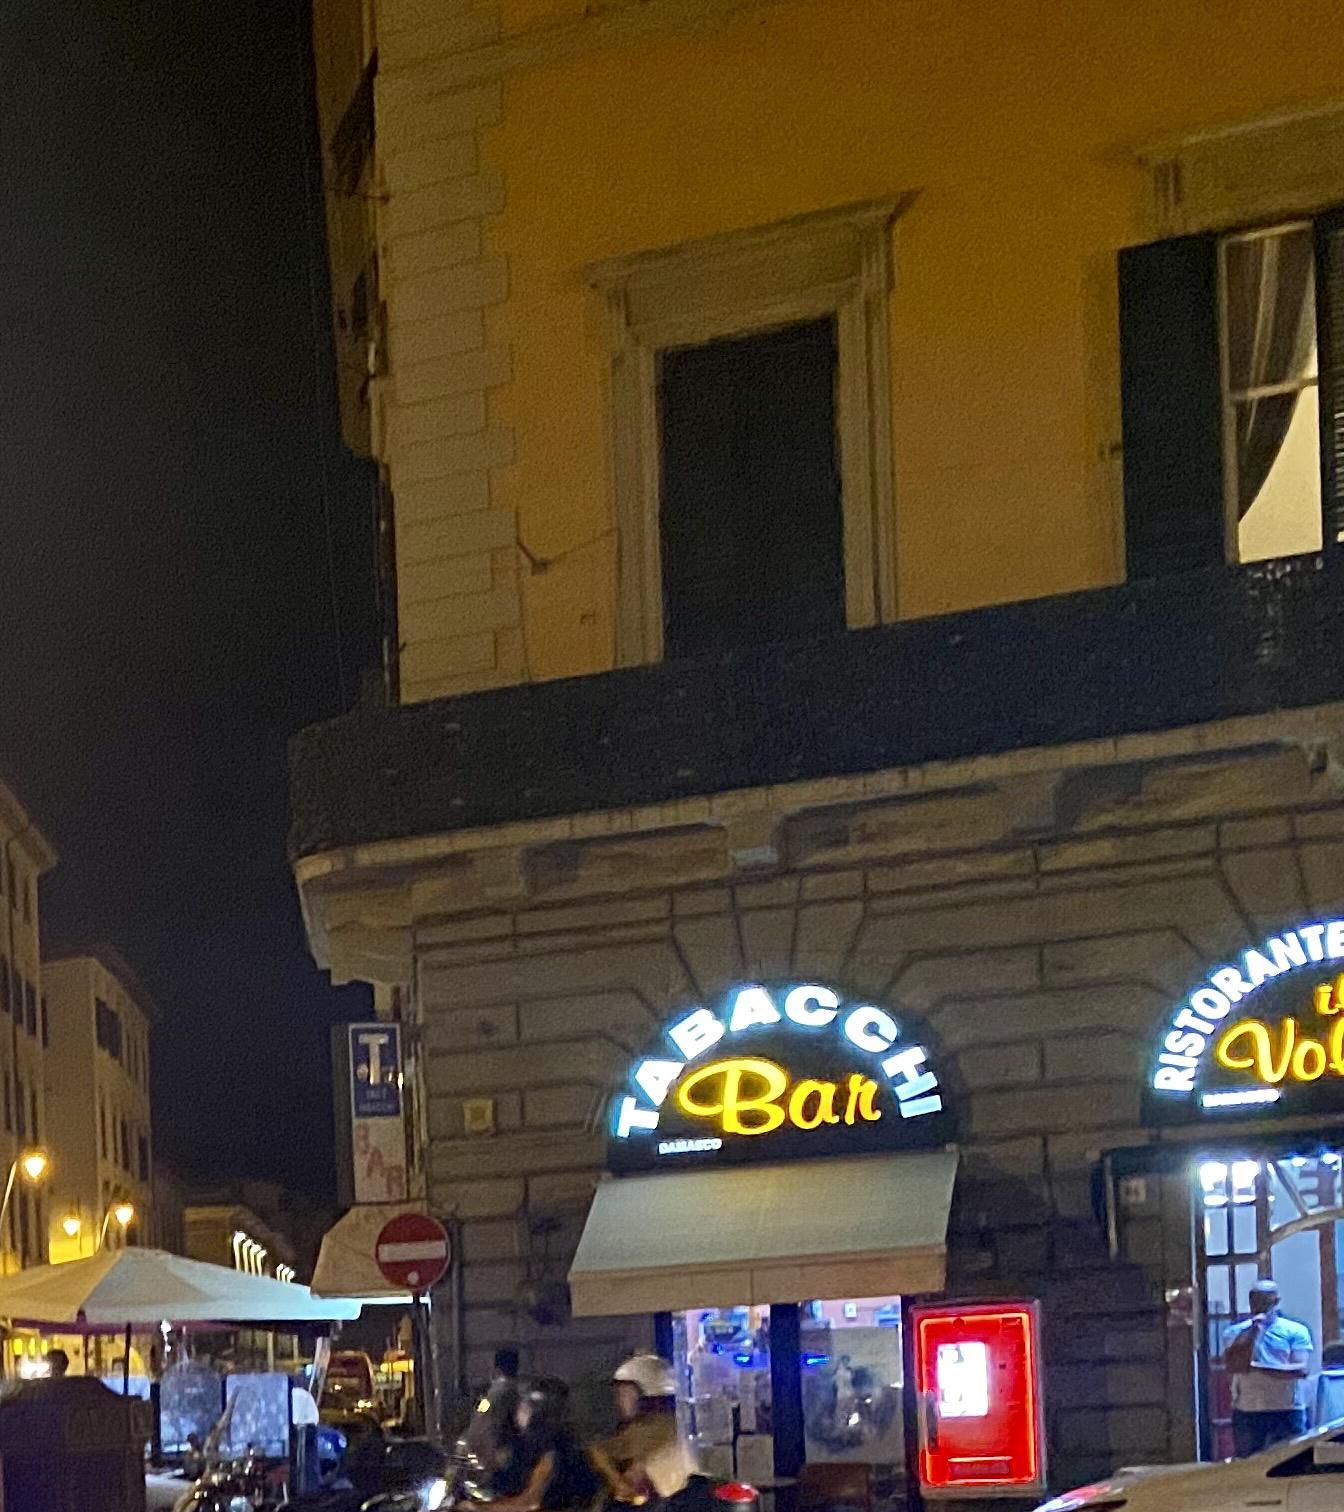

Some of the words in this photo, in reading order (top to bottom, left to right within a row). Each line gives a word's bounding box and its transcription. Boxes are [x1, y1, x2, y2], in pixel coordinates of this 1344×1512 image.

[358, 1033, 389, 1085] T
[616, 984, 942, 1138] TABACCHI
[1153, 921, 1344, 1091] RISTORANTE
[678, 1058, 882, 1135] Bar
